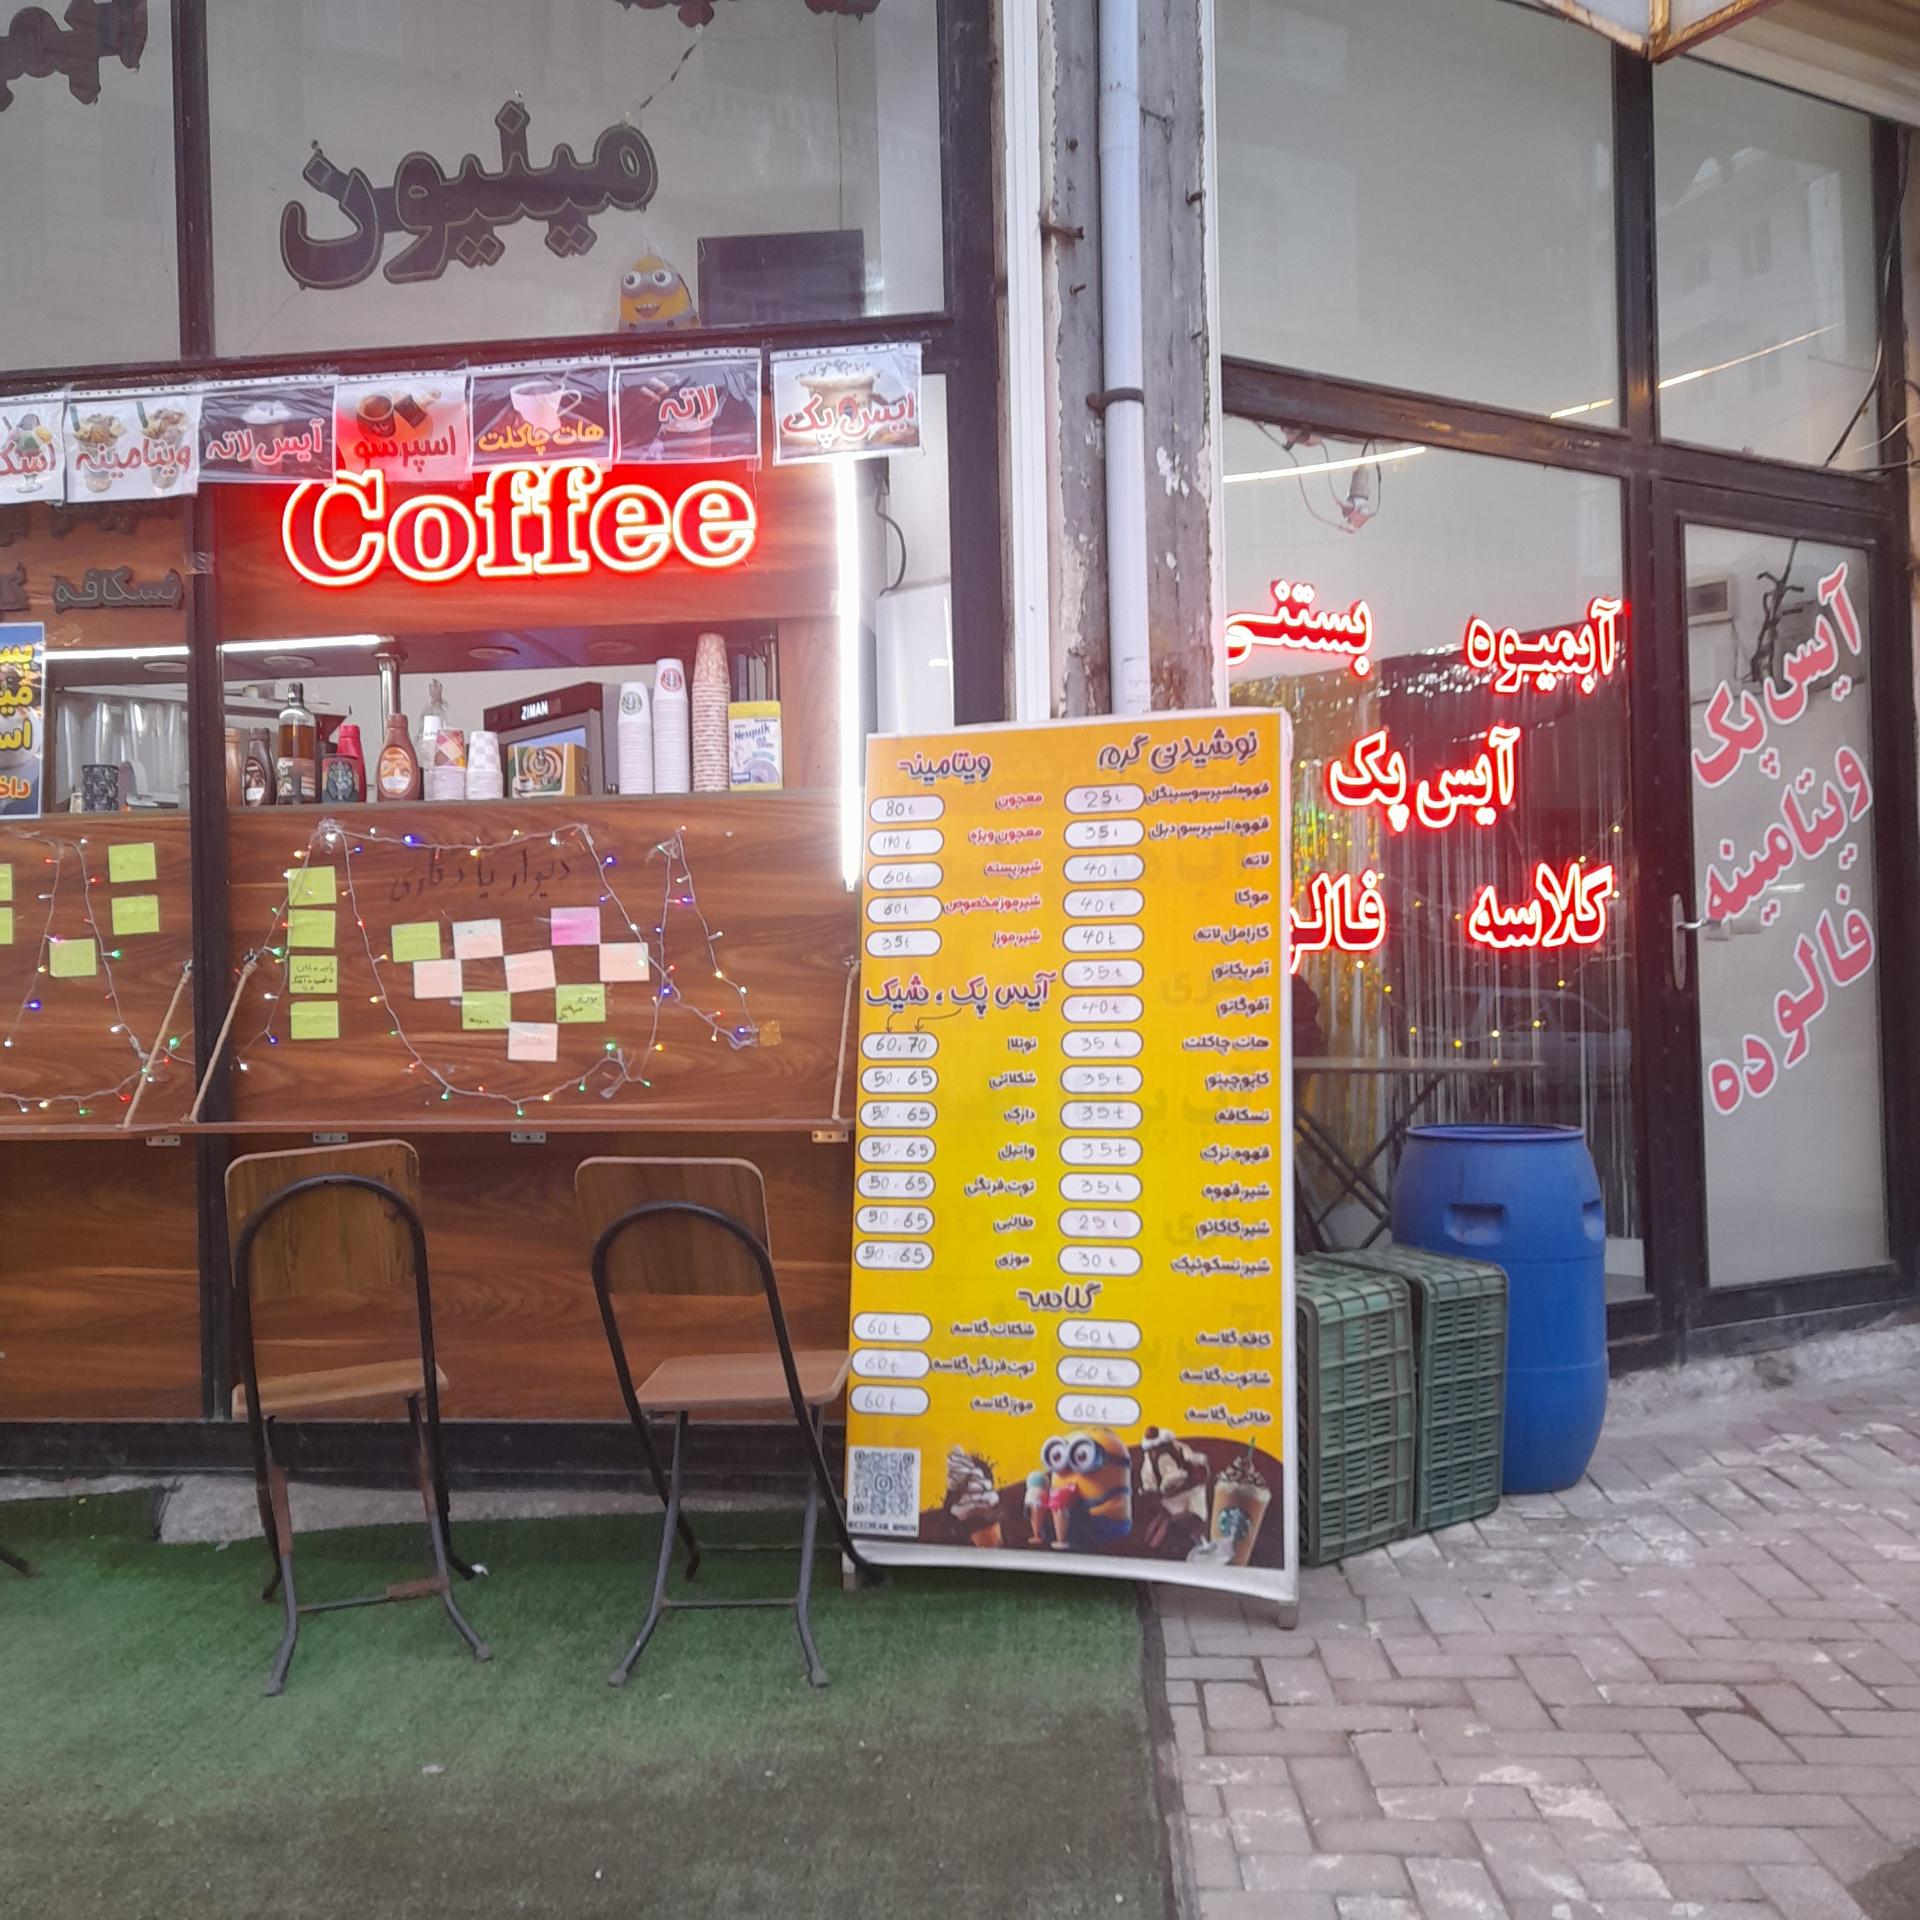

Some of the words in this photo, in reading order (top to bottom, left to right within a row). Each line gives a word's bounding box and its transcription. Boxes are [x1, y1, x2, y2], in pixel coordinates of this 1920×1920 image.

[280, 100, 659, 290] مینیون
[658, 383, 718, 423] لاته
[552, 418, 604, 445] هات
[782, 393, 835, 449] پک
[206, 428, 254, 462] لاته
[255, 418, 325, 465] آیس
[353, 424, 456, 472] اسپرسو
[478, 421, 550, 457] چاکلت
[75, 437, 192, 479] ویتامینه
[281, 458, 757, 587] Coffee
[1224, 579, 1373, 677] بستنی
[1467, 597, 1624, 694] آبمیوه
[1763, 560, 1862, 726] آیس
[520, 700, 549, 720] ZIMAN
[734, 723, 770, 742] Nesquik
[1691, 679, 1781, 789] پک
[1098, 735, 1149, 773] گرم
[1150, 728, 1259, 773] نوشیدنی
[1329, 729, 1410, 832] پک
[1416, 725, 1521, 829] آیس
[994, 793, 1044, 811] معجون
[968, 828, 995, 846] ویژه
[995, 828, 1044, 845] معجون
[1231, 817, 1270, 837] قهوه
[1704, 746, 1873, 926] ویتامینه
[1241, 852, 1270, 868] لاته
[1234, 888, 1270, 908] موکا
[1193, 926, 1221, 943] لاته
[1221, 924, 1270, 945] کارامل
[1211, 960, 1270, 981] آمریکانو
[865, 974, 930, 1013] شیک
[950, 976, 988, 1018] پک
[994, 972, 1058, 1013] آیس
[1708, 883, 1876, 1115] فالوده
[1216, 996, 1270, 1018] آفوگاتو
[1007, 1036, 1038, 1053] نوتلا
[1182, 1034, 1231, 1055] چاکلت
[1232, 1035, 1270, 1051] هات
[989, 1072, 1036, 1089] شکلاتی
[1205, 1070, 1271, 1092] کاپوچینو
[1004, 1107, 1036, 1124] دارک
[1215, 1107, 1270, 1124] نسکافه
[998, 1144, 1036, 1161] وانیل
[1231, 1145, 1271, 1164] قهوه
[1202, 1182, 1240, 1202] قهوه
[1239, 1183, 1271, 1203] شیر
[993, 1215, 1034, 1233] طالبی
[1239, 1221, 1271, 1240] شیر
[995, 1253, 1030, 1269] موزی
[1240, 1258, 1271, 1279] شیر
[950, 1319, 990, 1336] گلاسه
[989, 1321, 1036, 1337] شکلات
[1196, 1330, 1238, 1345] گلاسه
[1238, 1333, 1271, 1347] کافه
[1180, 1367, 1222, 1383] گلاسه
[970, 1395, 1009, 1411] گلاسه
[1185, 1406, 1228, 1422] گلاسه
